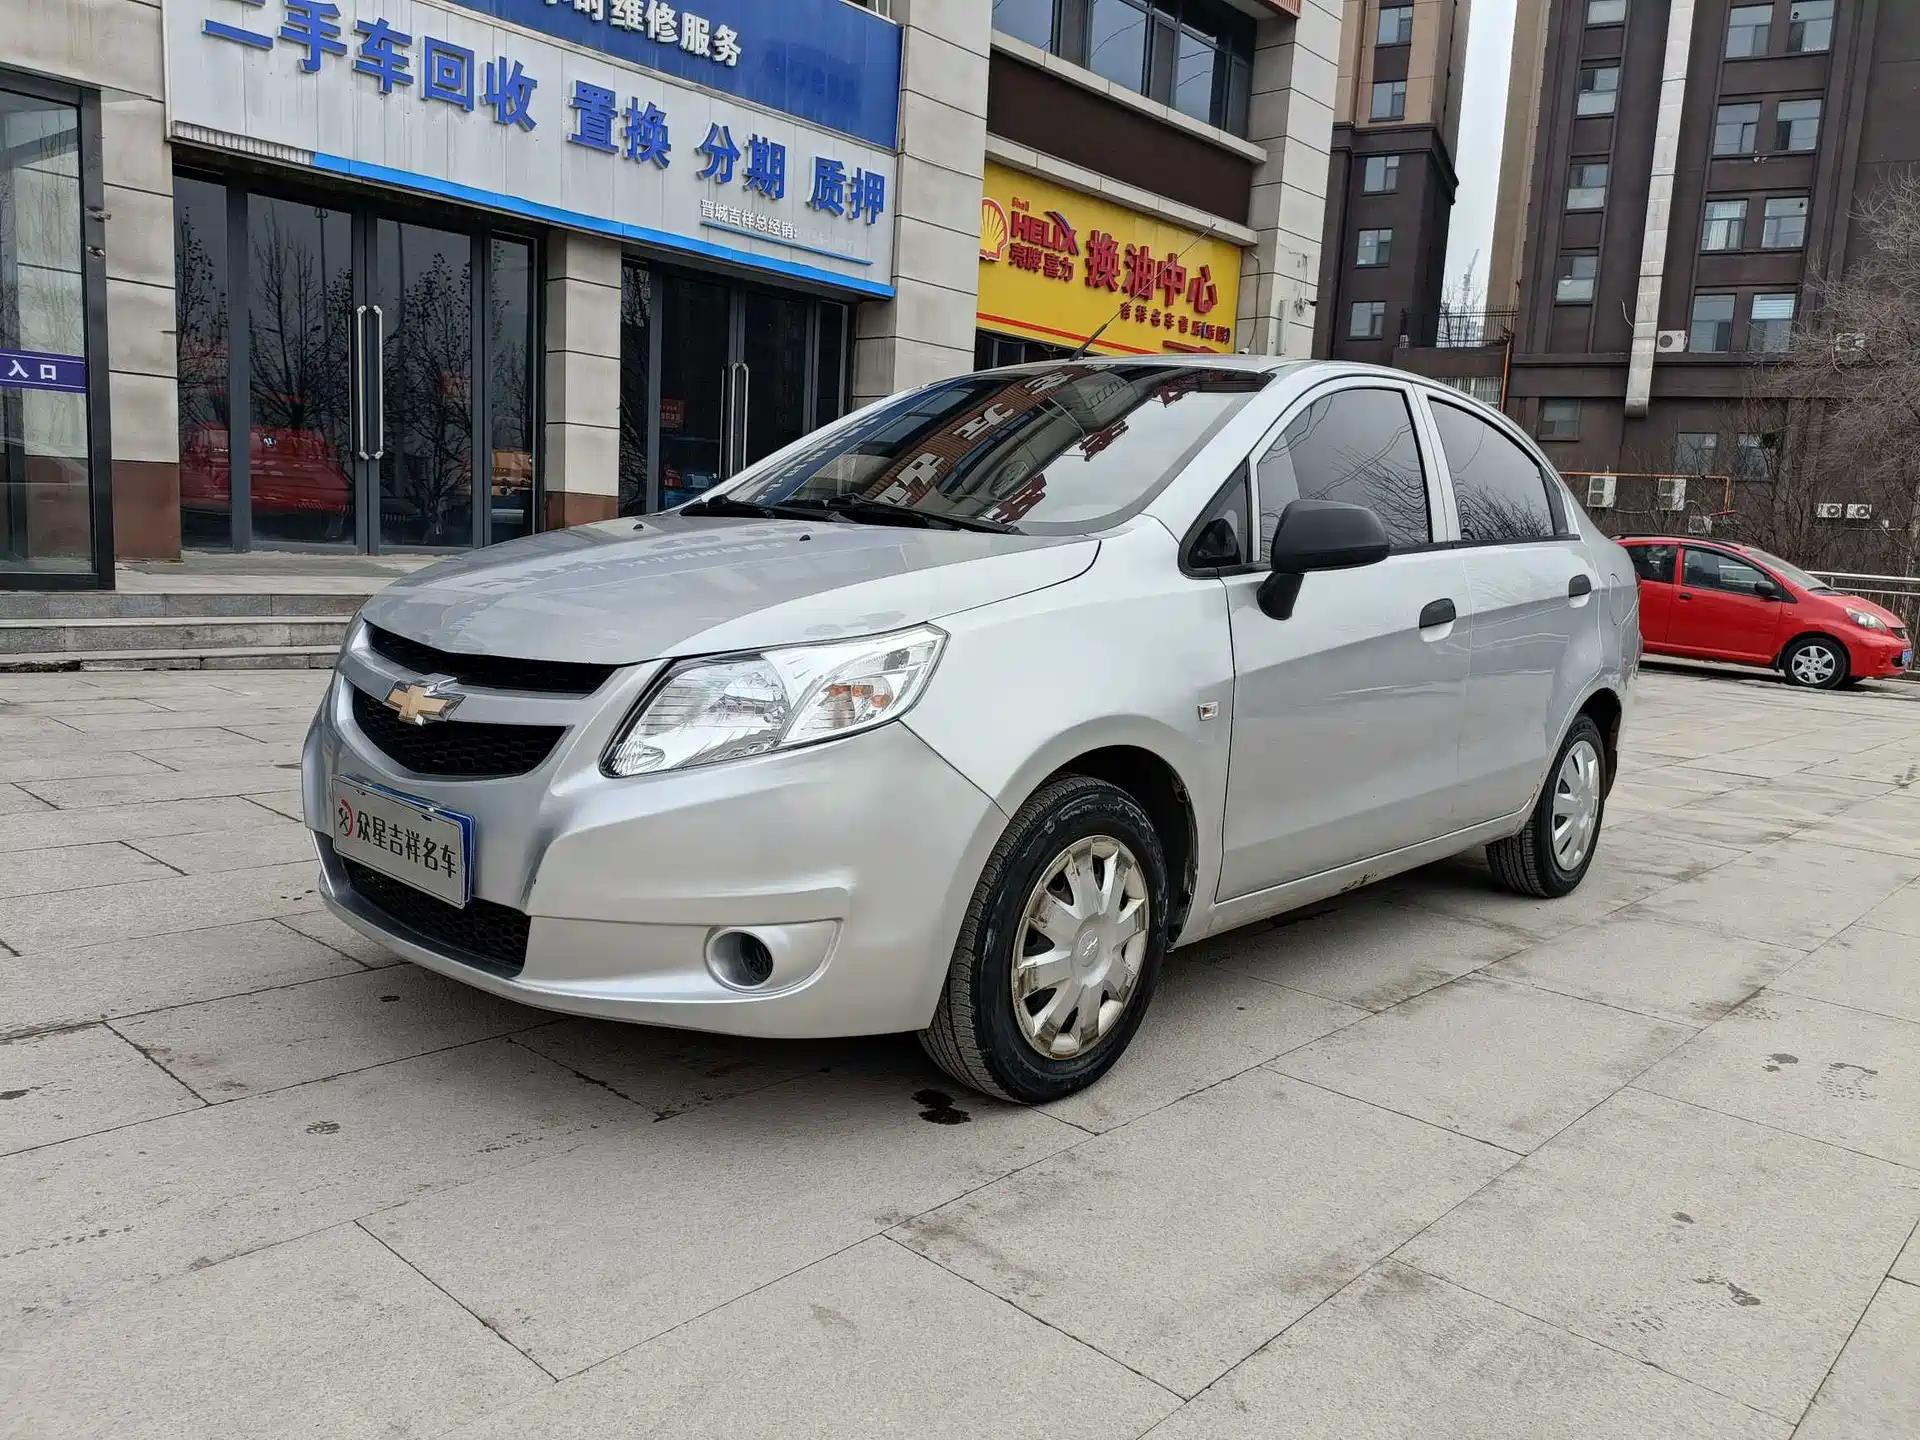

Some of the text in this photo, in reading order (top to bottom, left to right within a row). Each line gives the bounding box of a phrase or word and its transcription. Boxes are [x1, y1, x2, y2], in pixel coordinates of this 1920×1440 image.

[201, 0, 886, 225] 二手车回收 置换 分期 质押
[1010, 210, 1080, 256] HELIX
[1084, 229, 1218, 314] 换油中心
[7, 359, 57, 381] 入口
[356, 810, 457, 879] 众星吉祥名车
